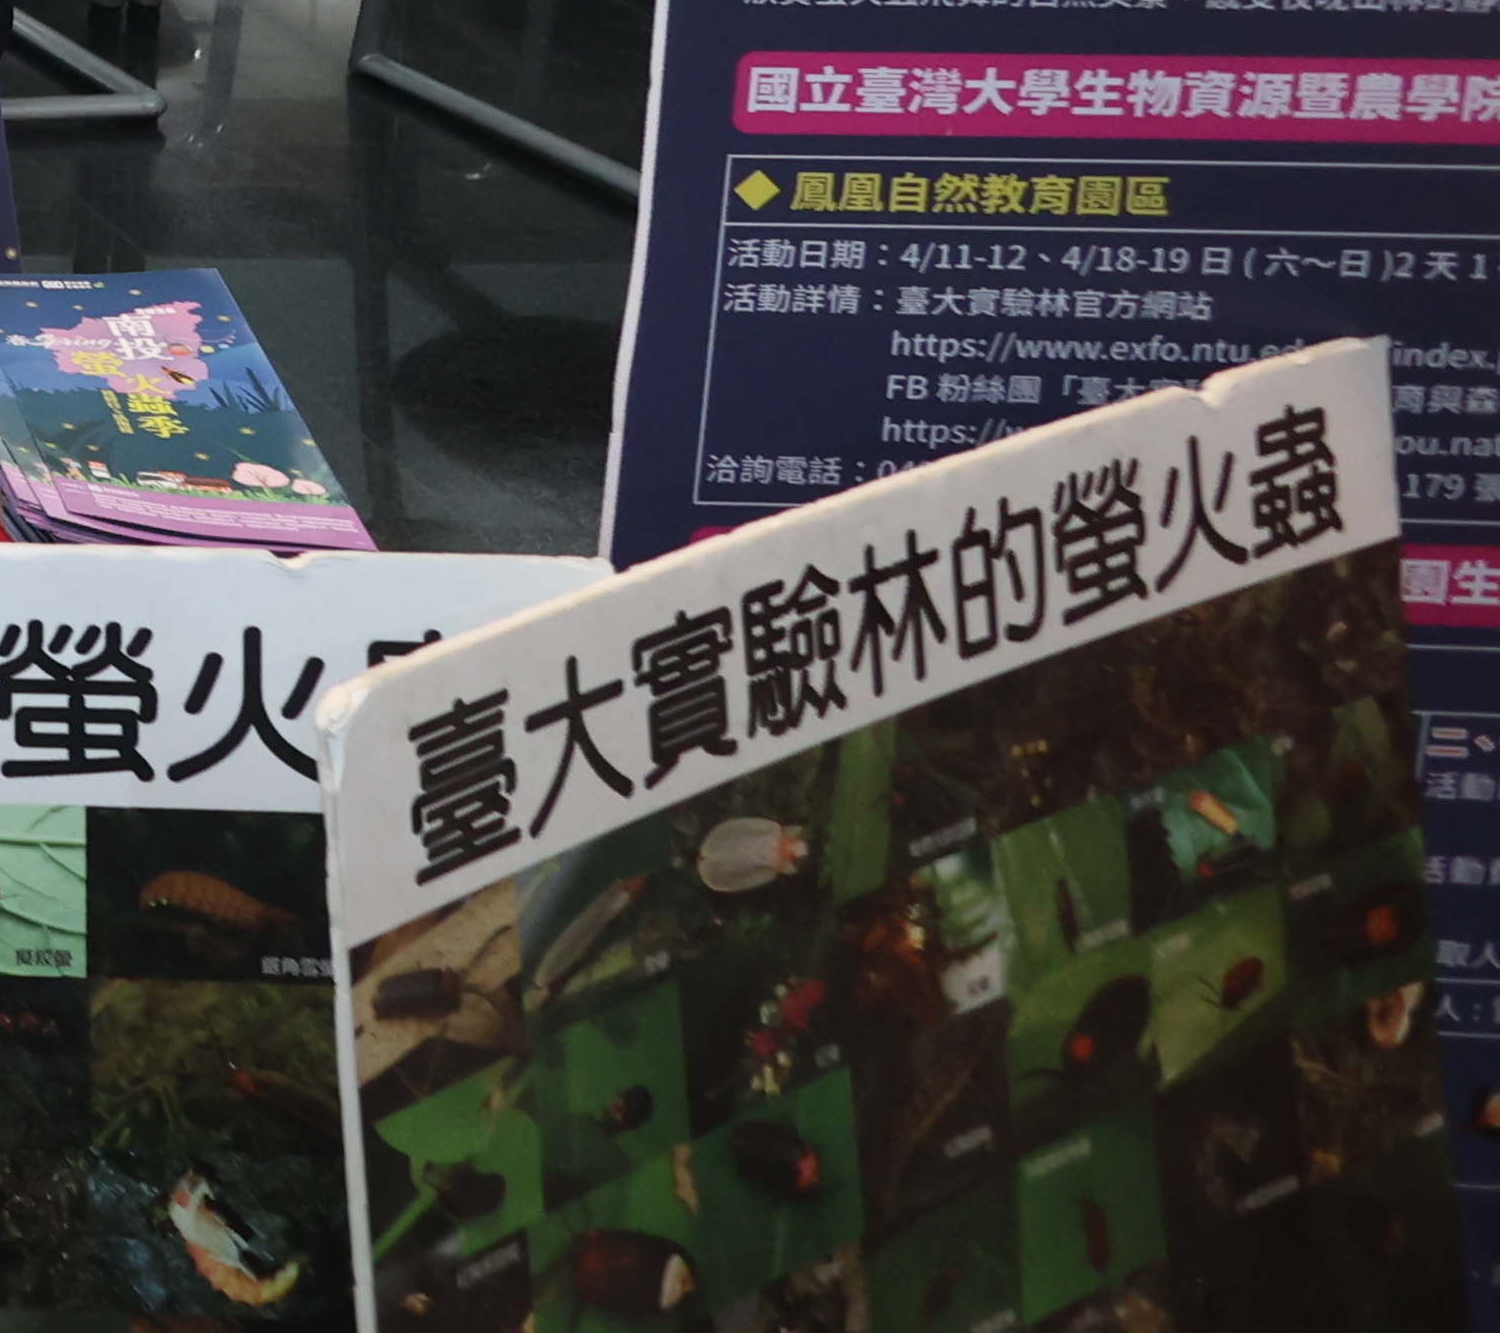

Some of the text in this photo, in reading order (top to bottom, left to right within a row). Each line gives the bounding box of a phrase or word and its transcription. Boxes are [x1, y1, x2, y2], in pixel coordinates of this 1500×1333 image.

[746, 65, 1500, 125] 國立臺灣大學生物資源暨農學院
[789, 170, 1171, 218] 鳳凰自然教育園區
[100, 314, 174, 362] 南投
[71, 350, 190, 439] 螢火蟲季
[886, 374, 928, 402] FB
[1402, 473, 1466, 501] 179
[406, 403, 1345, 888] 臺大實驗林的螢火蟲
